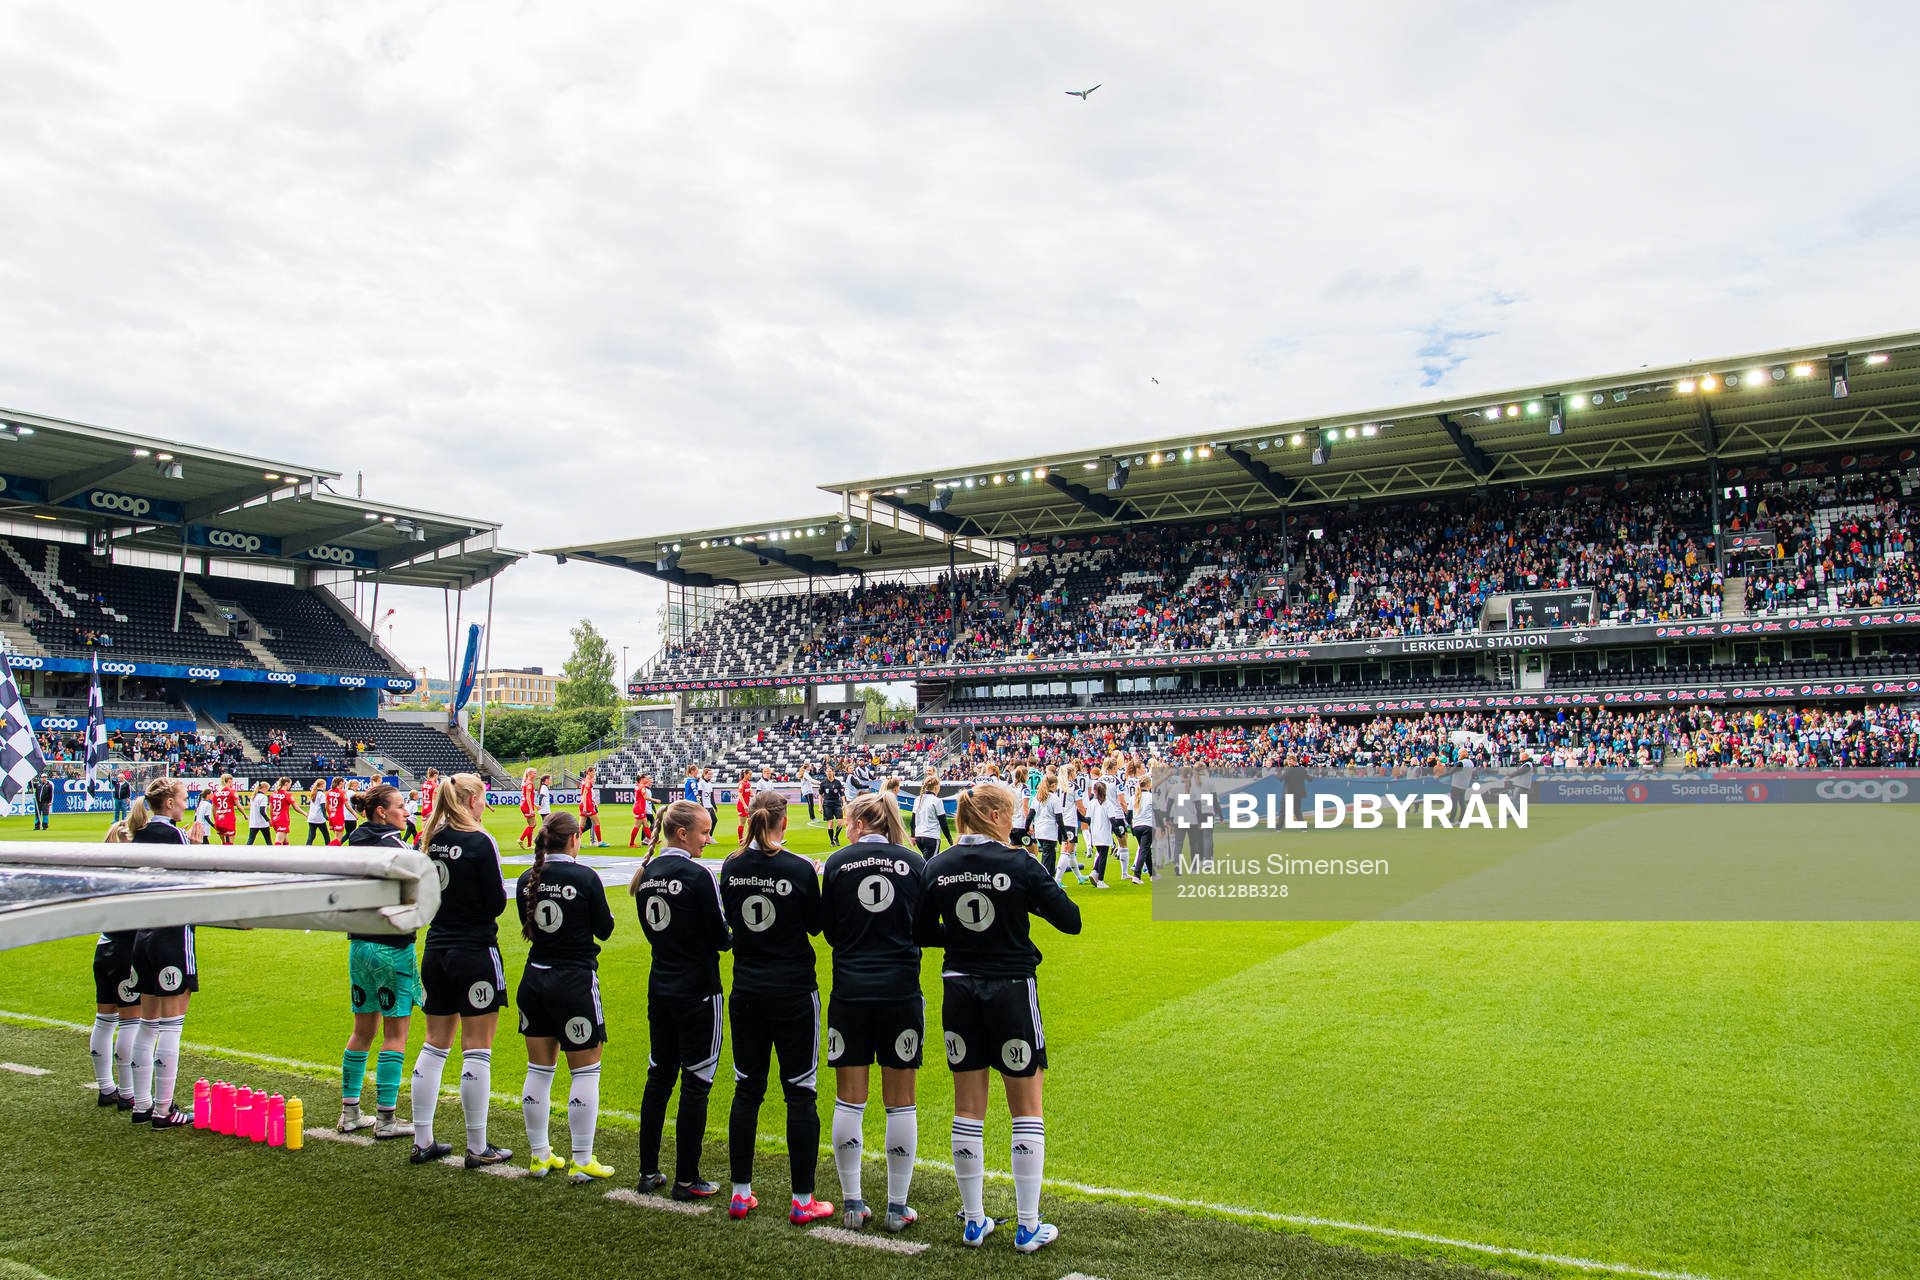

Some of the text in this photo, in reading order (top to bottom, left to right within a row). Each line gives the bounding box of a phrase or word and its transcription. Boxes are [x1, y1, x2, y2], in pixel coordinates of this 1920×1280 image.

[91, 491, 150, 517] coop
[208, 529, 261, 553] coop
[308, 545, 355, 565] coop
[1401, 634, 1548, 653] LERKENDAL STADION
[101, 662, 136, 675] coop
[188, 667, 220, 680] coop
[267, 672, 297, 684] coop
[339, 676, 366, 687] coop
[387, 679, 412, 690] coop
[41, 718, 78, 731] coop
[134, 720, 168, 732] coop
[208, 781, 244, 791] Scdic
[1558, 784, 1641, 799] SpareBank 1
[1672, 784, 1760, 798] SpareBank 1
[1816, 780, 1909, 803] coop
[216, 797, 228, 810] 36
[272, 799, 282, 812] 33
[329, 797, 339, 808] 19
[501, 796, 521, 805] OBO
[557, 794, 581, 804] OBO
[840, 857, 893, 872] SpareBank
[729, 875, 775, 888] SpareBank
[937, 871, 991, 887] SpareBank
